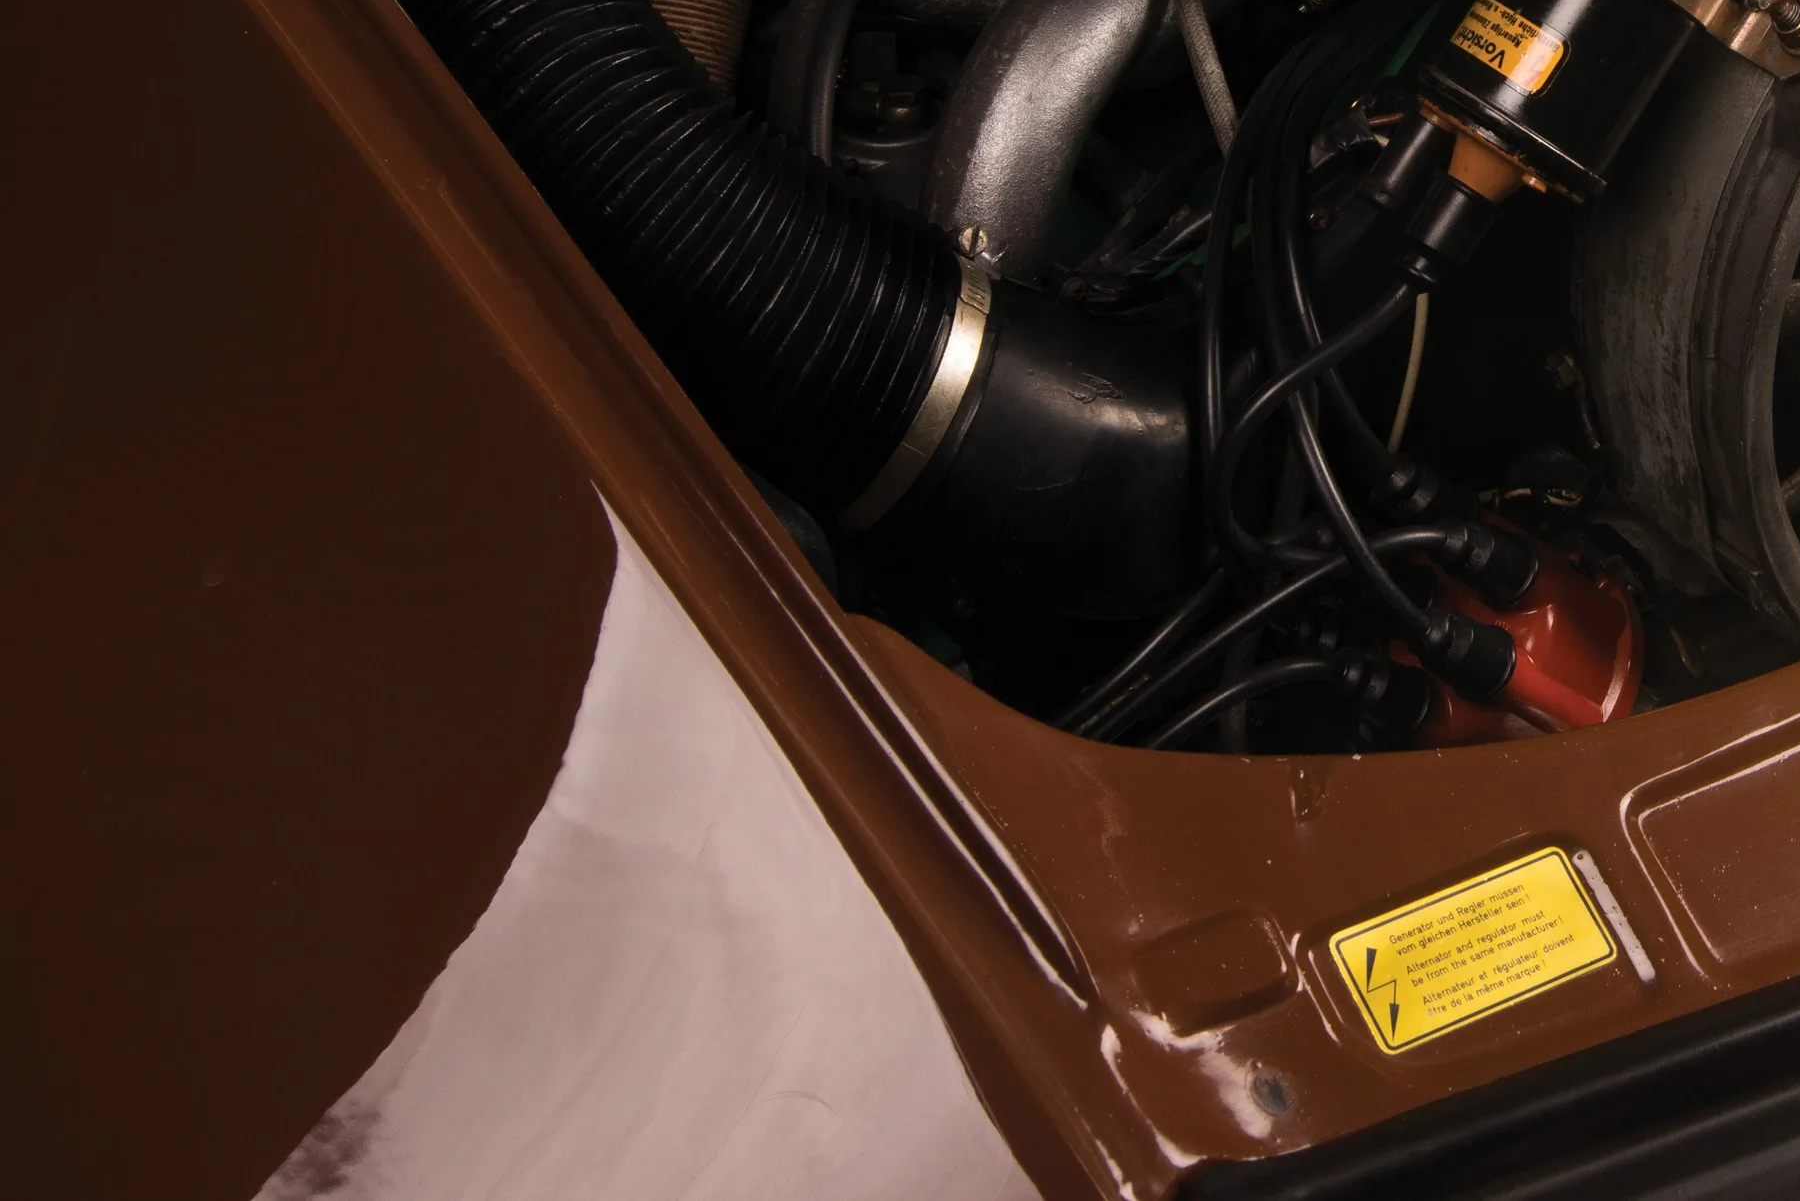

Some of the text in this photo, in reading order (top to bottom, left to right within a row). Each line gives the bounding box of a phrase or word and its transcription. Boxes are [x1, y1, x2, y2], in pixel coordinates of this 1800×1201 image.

[1389, 920, 1435, 946] Generator
[1437, 911, 1455, 925] und
[1455, 897, 1487, 920] Regler
[1396, 941, 1417, 957] vom
[1418, 924, 1457, 951] gleichen
[1458, 904, 1504, 930] Hersteller
[1505, 899, 1525, 913] sein
[1405, 909, 1546, 975] Alternator and regulator must
[1411, 973, 1424, 987] be
[1424, 965, 1450, 982] from
[1451, 958, 1467, 971] the
[1469, 947, 1495, 964] same
[1496, 918, 1558, 959] manufacturer
[1422, 933, 1575, 1006] Alternateur et régulateur doivent
[1450, 996, 1462, 1010] de
[1464, 989, 1474, 1004] la
[1475, 980, 1504, 999] même
[1506, 964, 1540, 989] marque
